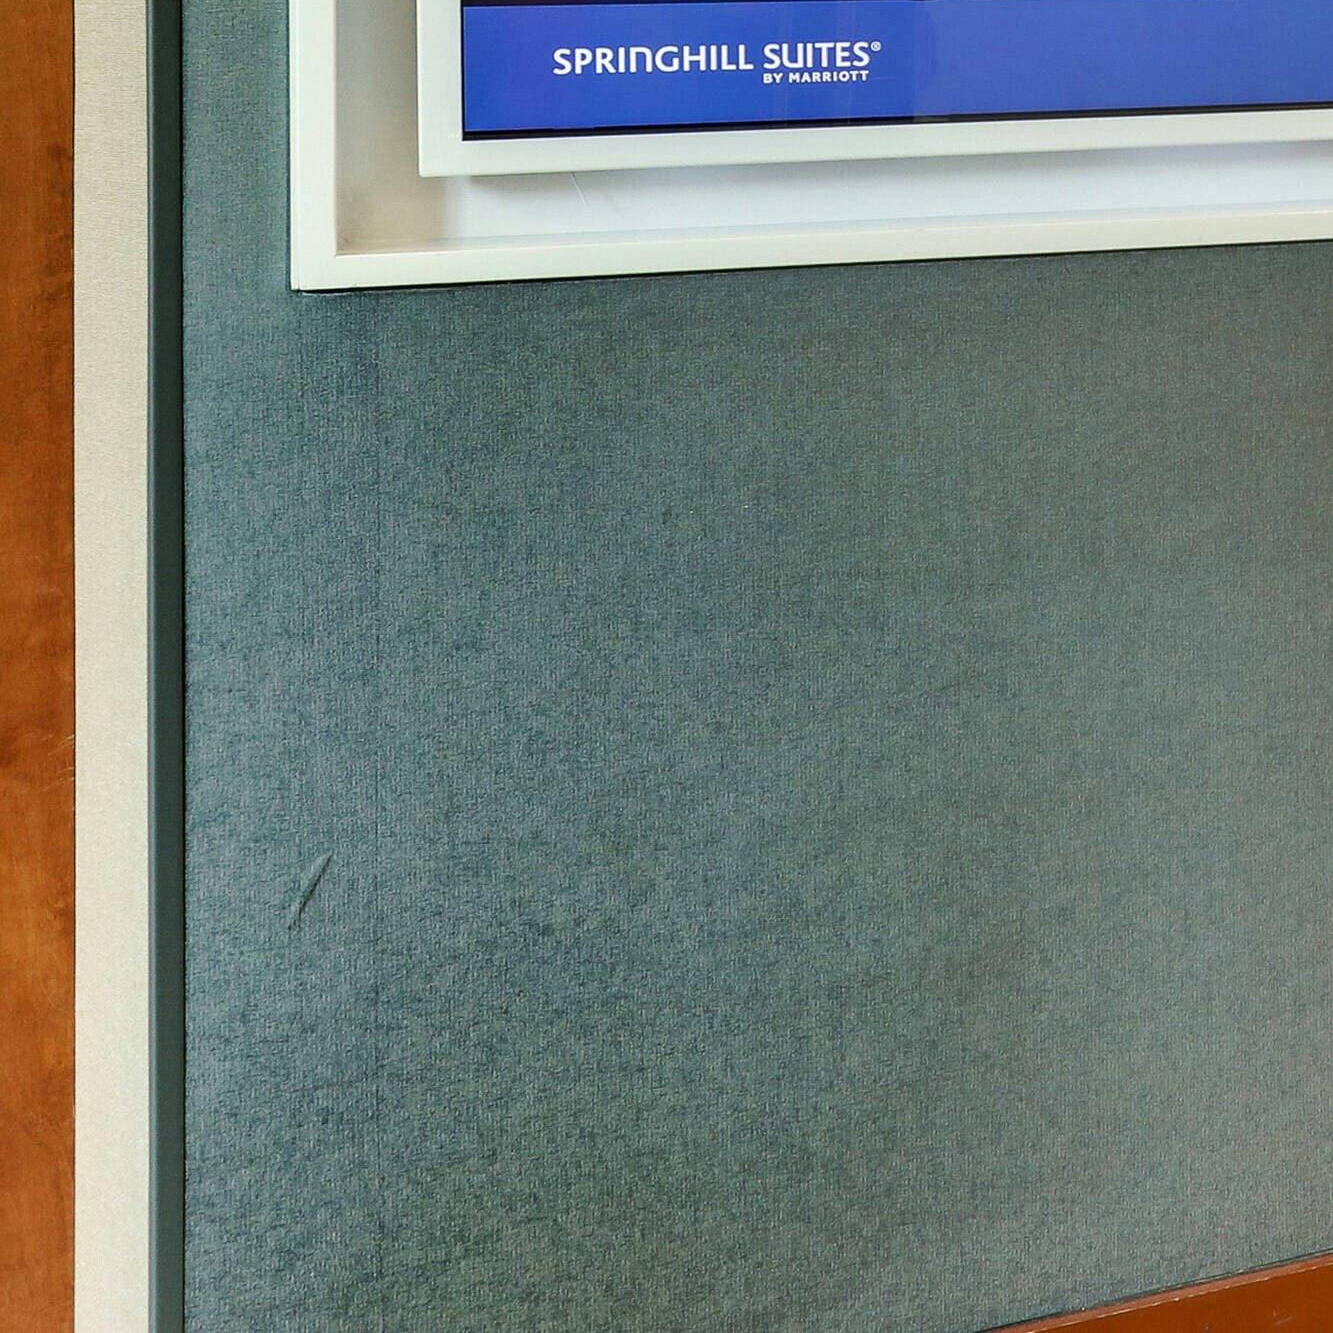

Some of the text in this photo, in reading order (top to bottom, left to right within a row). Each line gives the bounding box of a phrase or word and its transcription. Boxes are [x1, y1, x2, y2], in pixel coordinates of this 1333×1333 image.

[552, 44, 755, 75] SPRINGHILL
[762, 70, 870, 84] BY MARRIOTT
